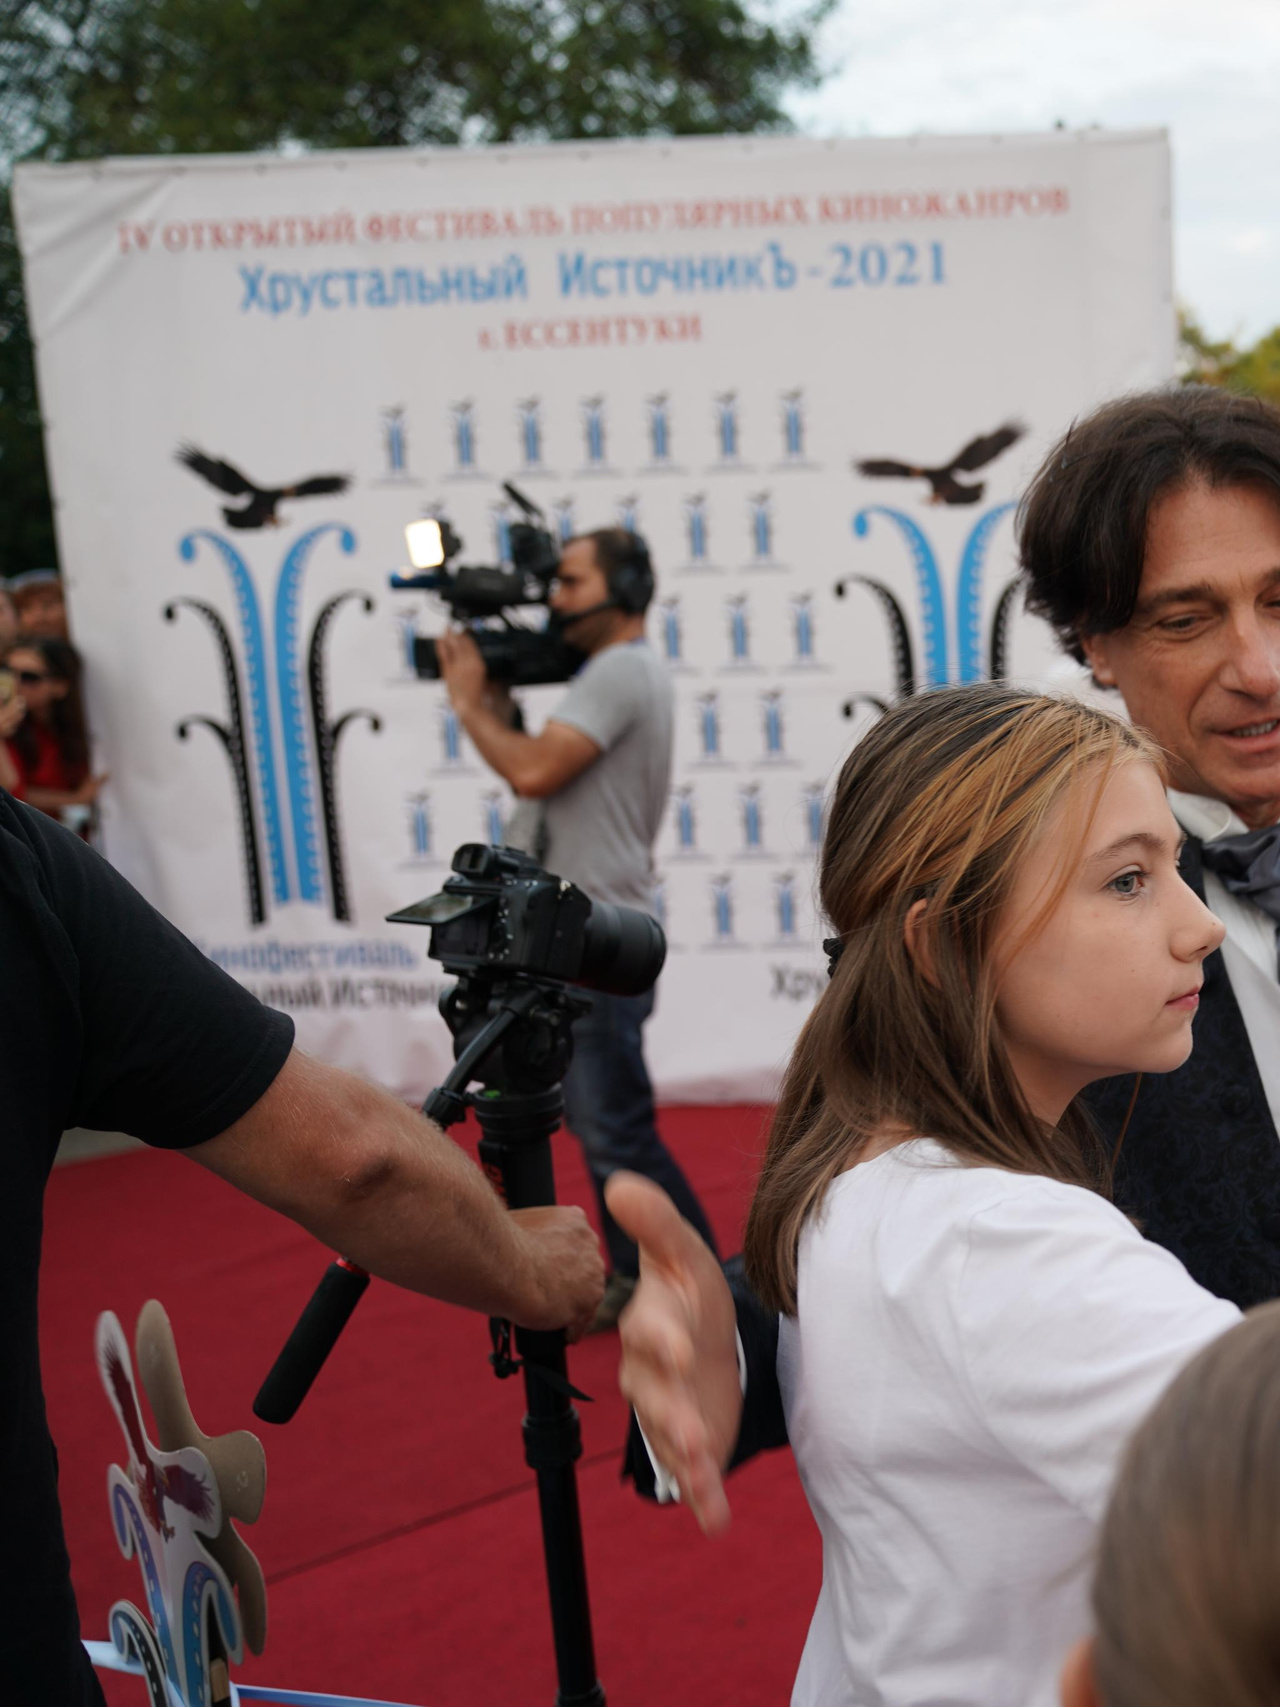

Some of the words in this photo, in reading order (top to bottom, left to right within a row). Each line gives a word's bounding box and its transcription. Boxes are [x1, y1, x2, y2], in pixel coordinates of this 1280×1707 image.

[118, 221, 151, 254] IV
[162, 212, 357, 253] ОТКРЫТЫЙ
[362, 205, 564, 243] ФЕСТИВАЛЬ
[569, 194, 810, 235] ПОПУЛЯРНЫХ
[817, 184, 1071, 223] КИНОЖАНРОВ
[239, 252, 529, 318] Хрустальный
[503, 312, 703, 351] ЕССЕНТУКИ
